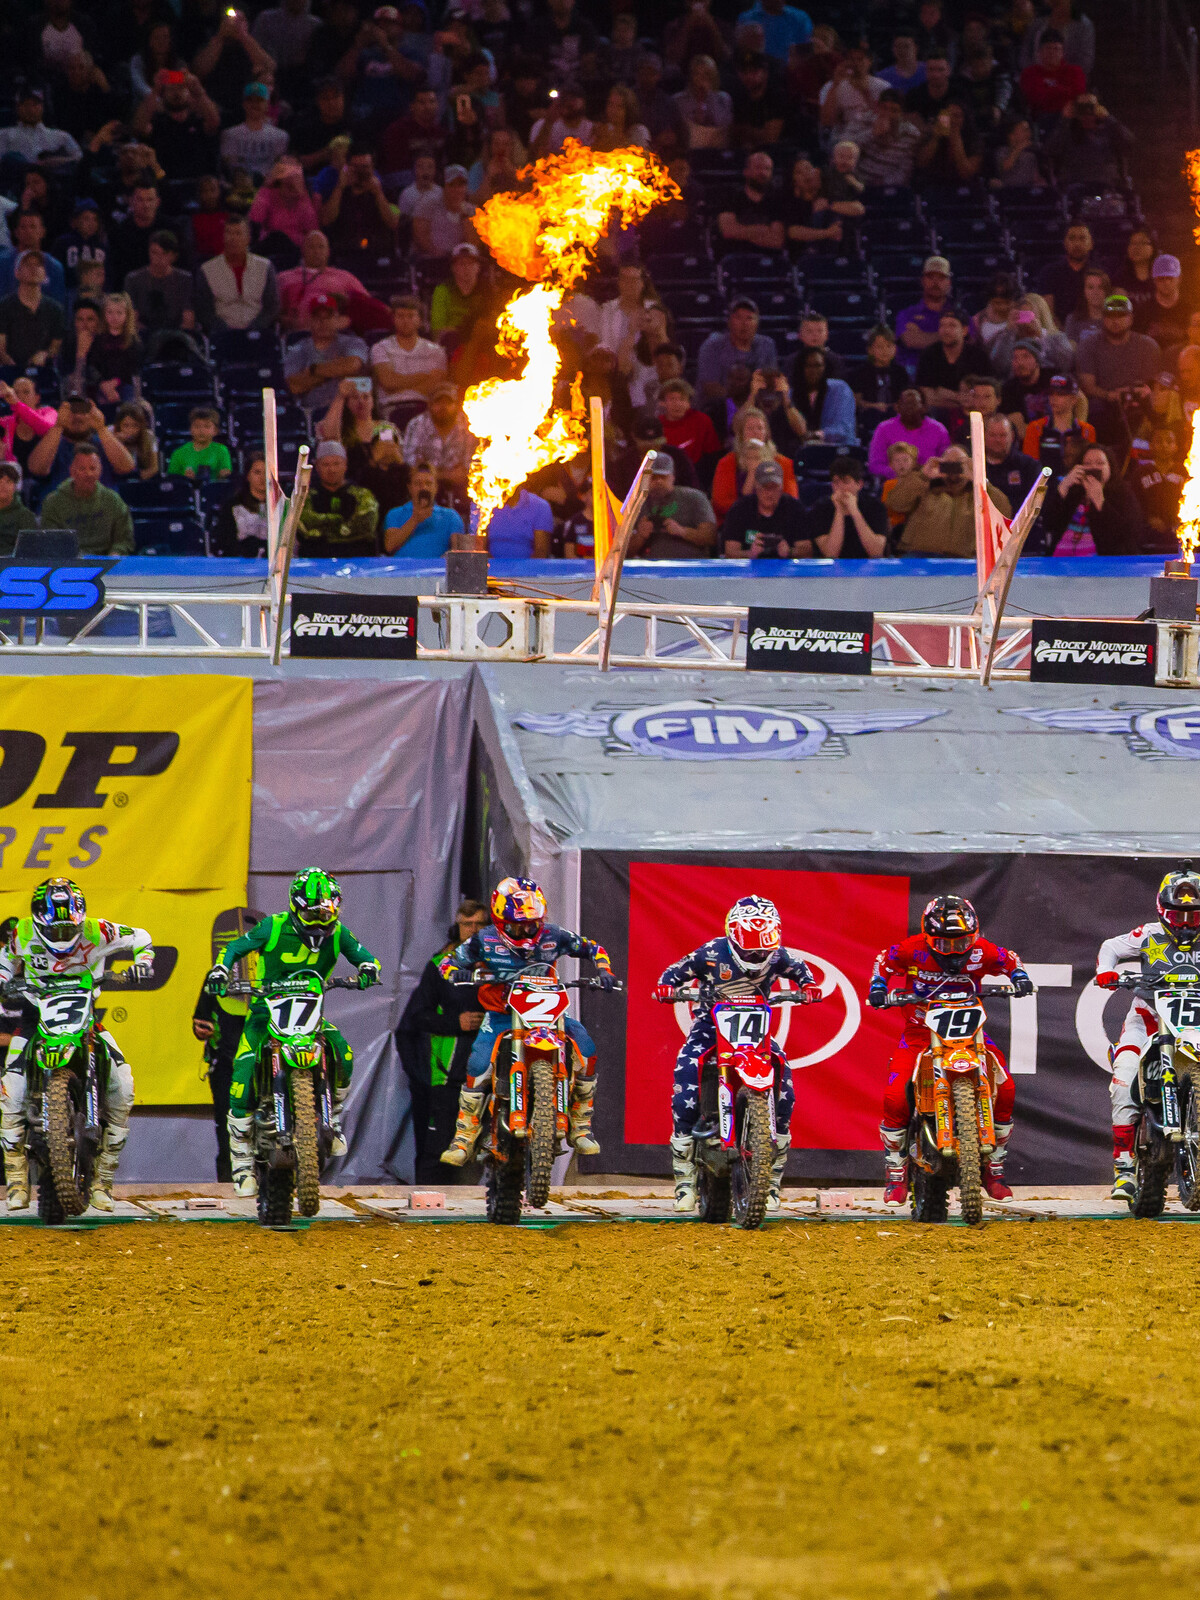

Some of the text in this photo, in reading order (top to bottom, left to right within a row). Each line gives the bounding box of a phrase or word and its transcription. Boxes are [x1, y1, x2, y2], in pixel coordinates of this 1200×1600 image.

[312, 613, 408, 625] ROCKY MOUNTAIN
[767, 627, 863, 641] ROCKY MOUNTAIN
[1052, 639, 1147, 652] ROCKY MOUNTAIN
[646, 716, 797, 744] FIM
[45, 996, 87, 1028] 3
[272, 998, 319, 1029] 17
[521, 993, 560, 1021] 2
[724, 1013, 763, 1043] 14
[933, 1010, 982, 1038] 19
[1165, 1086, 1173, 1124] DUNLOP
